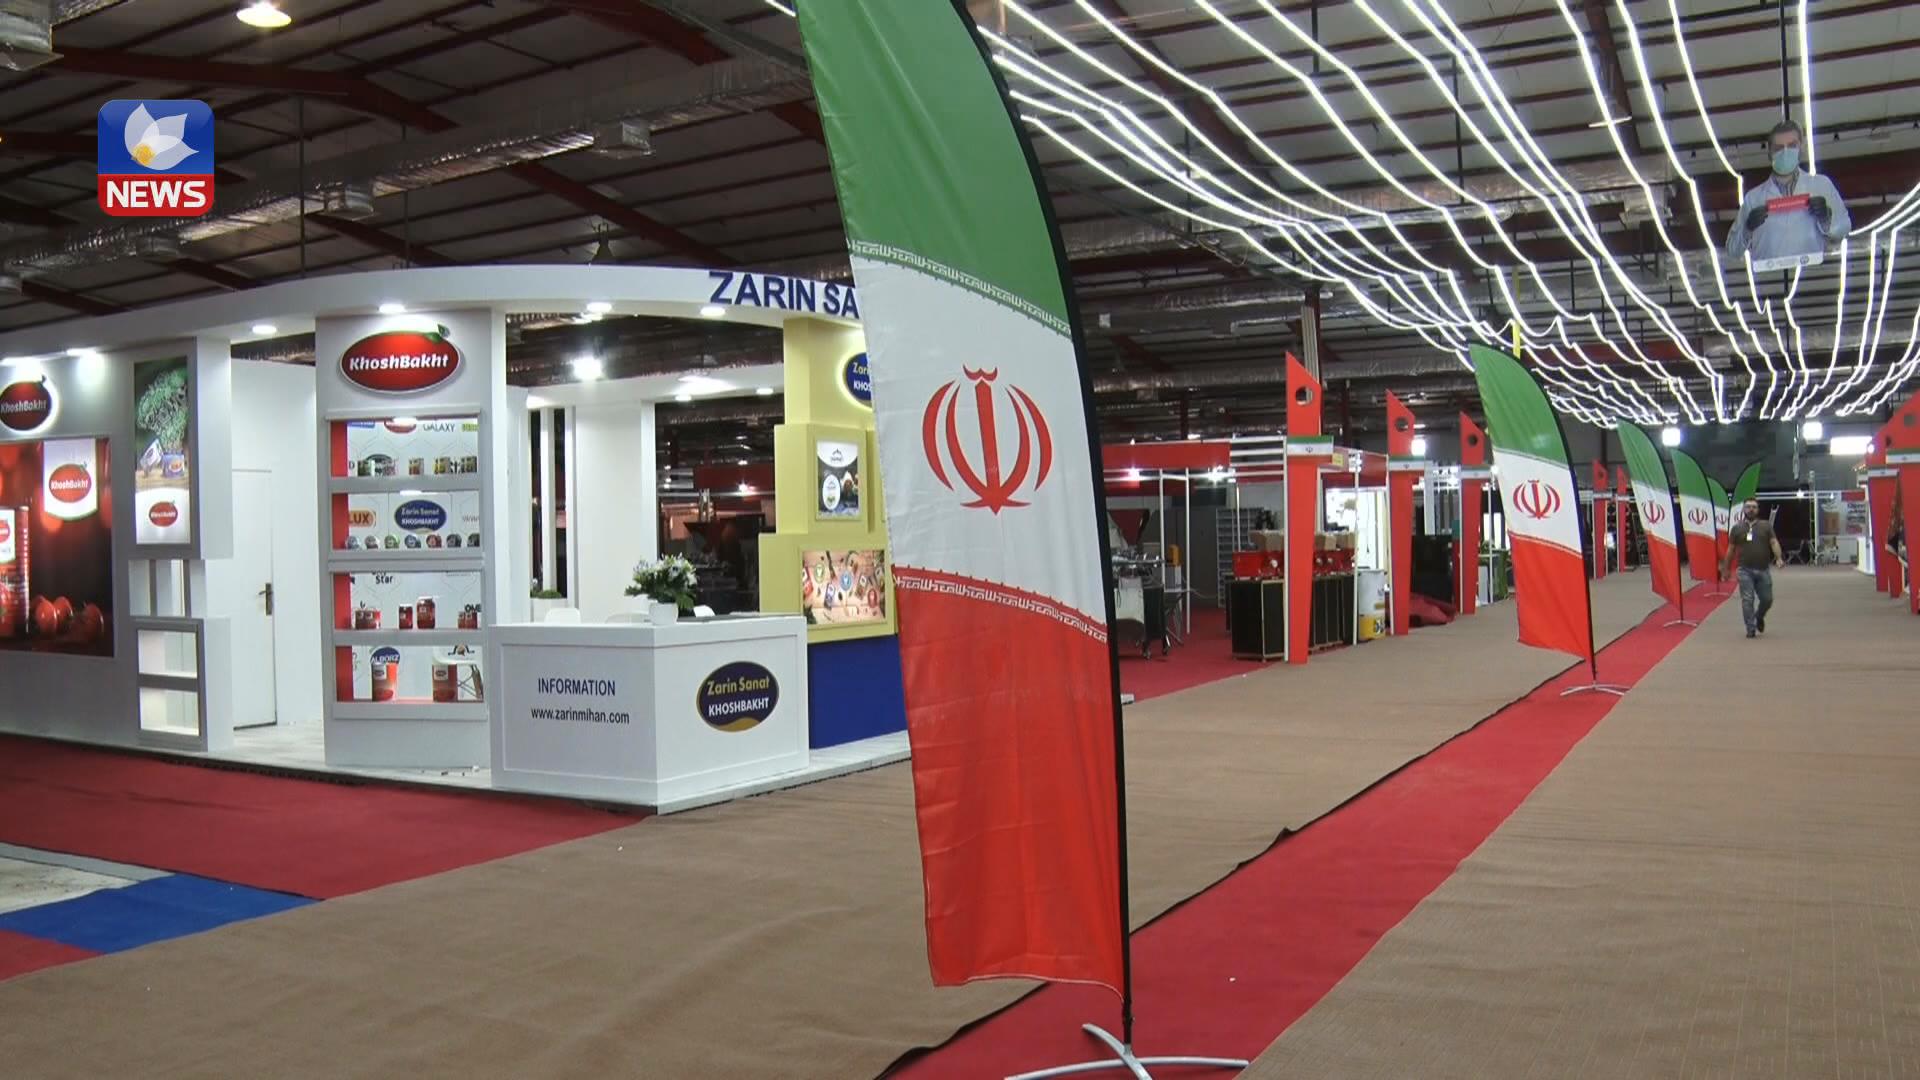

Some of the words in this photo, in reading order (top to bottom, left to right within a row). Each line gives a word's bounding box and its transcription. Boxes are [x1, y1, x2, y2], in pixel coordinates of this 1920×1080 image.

[709, 271, 816, 313] ZARIN
[823, 283, 860, 319] SA
[349, 353, 449, 371] KhoshBakht
[51, 479, 88, 490] KhoshBakht
[538, 678, 616, 696] INFORMATION
[707, 678, 737, 696] Zarin
[739, 676, 770, 692] Sanat
[531, 707, 630, 724] www.zarinmihan.com
[708, 697, 769, 717] KHOSHBAKHT
